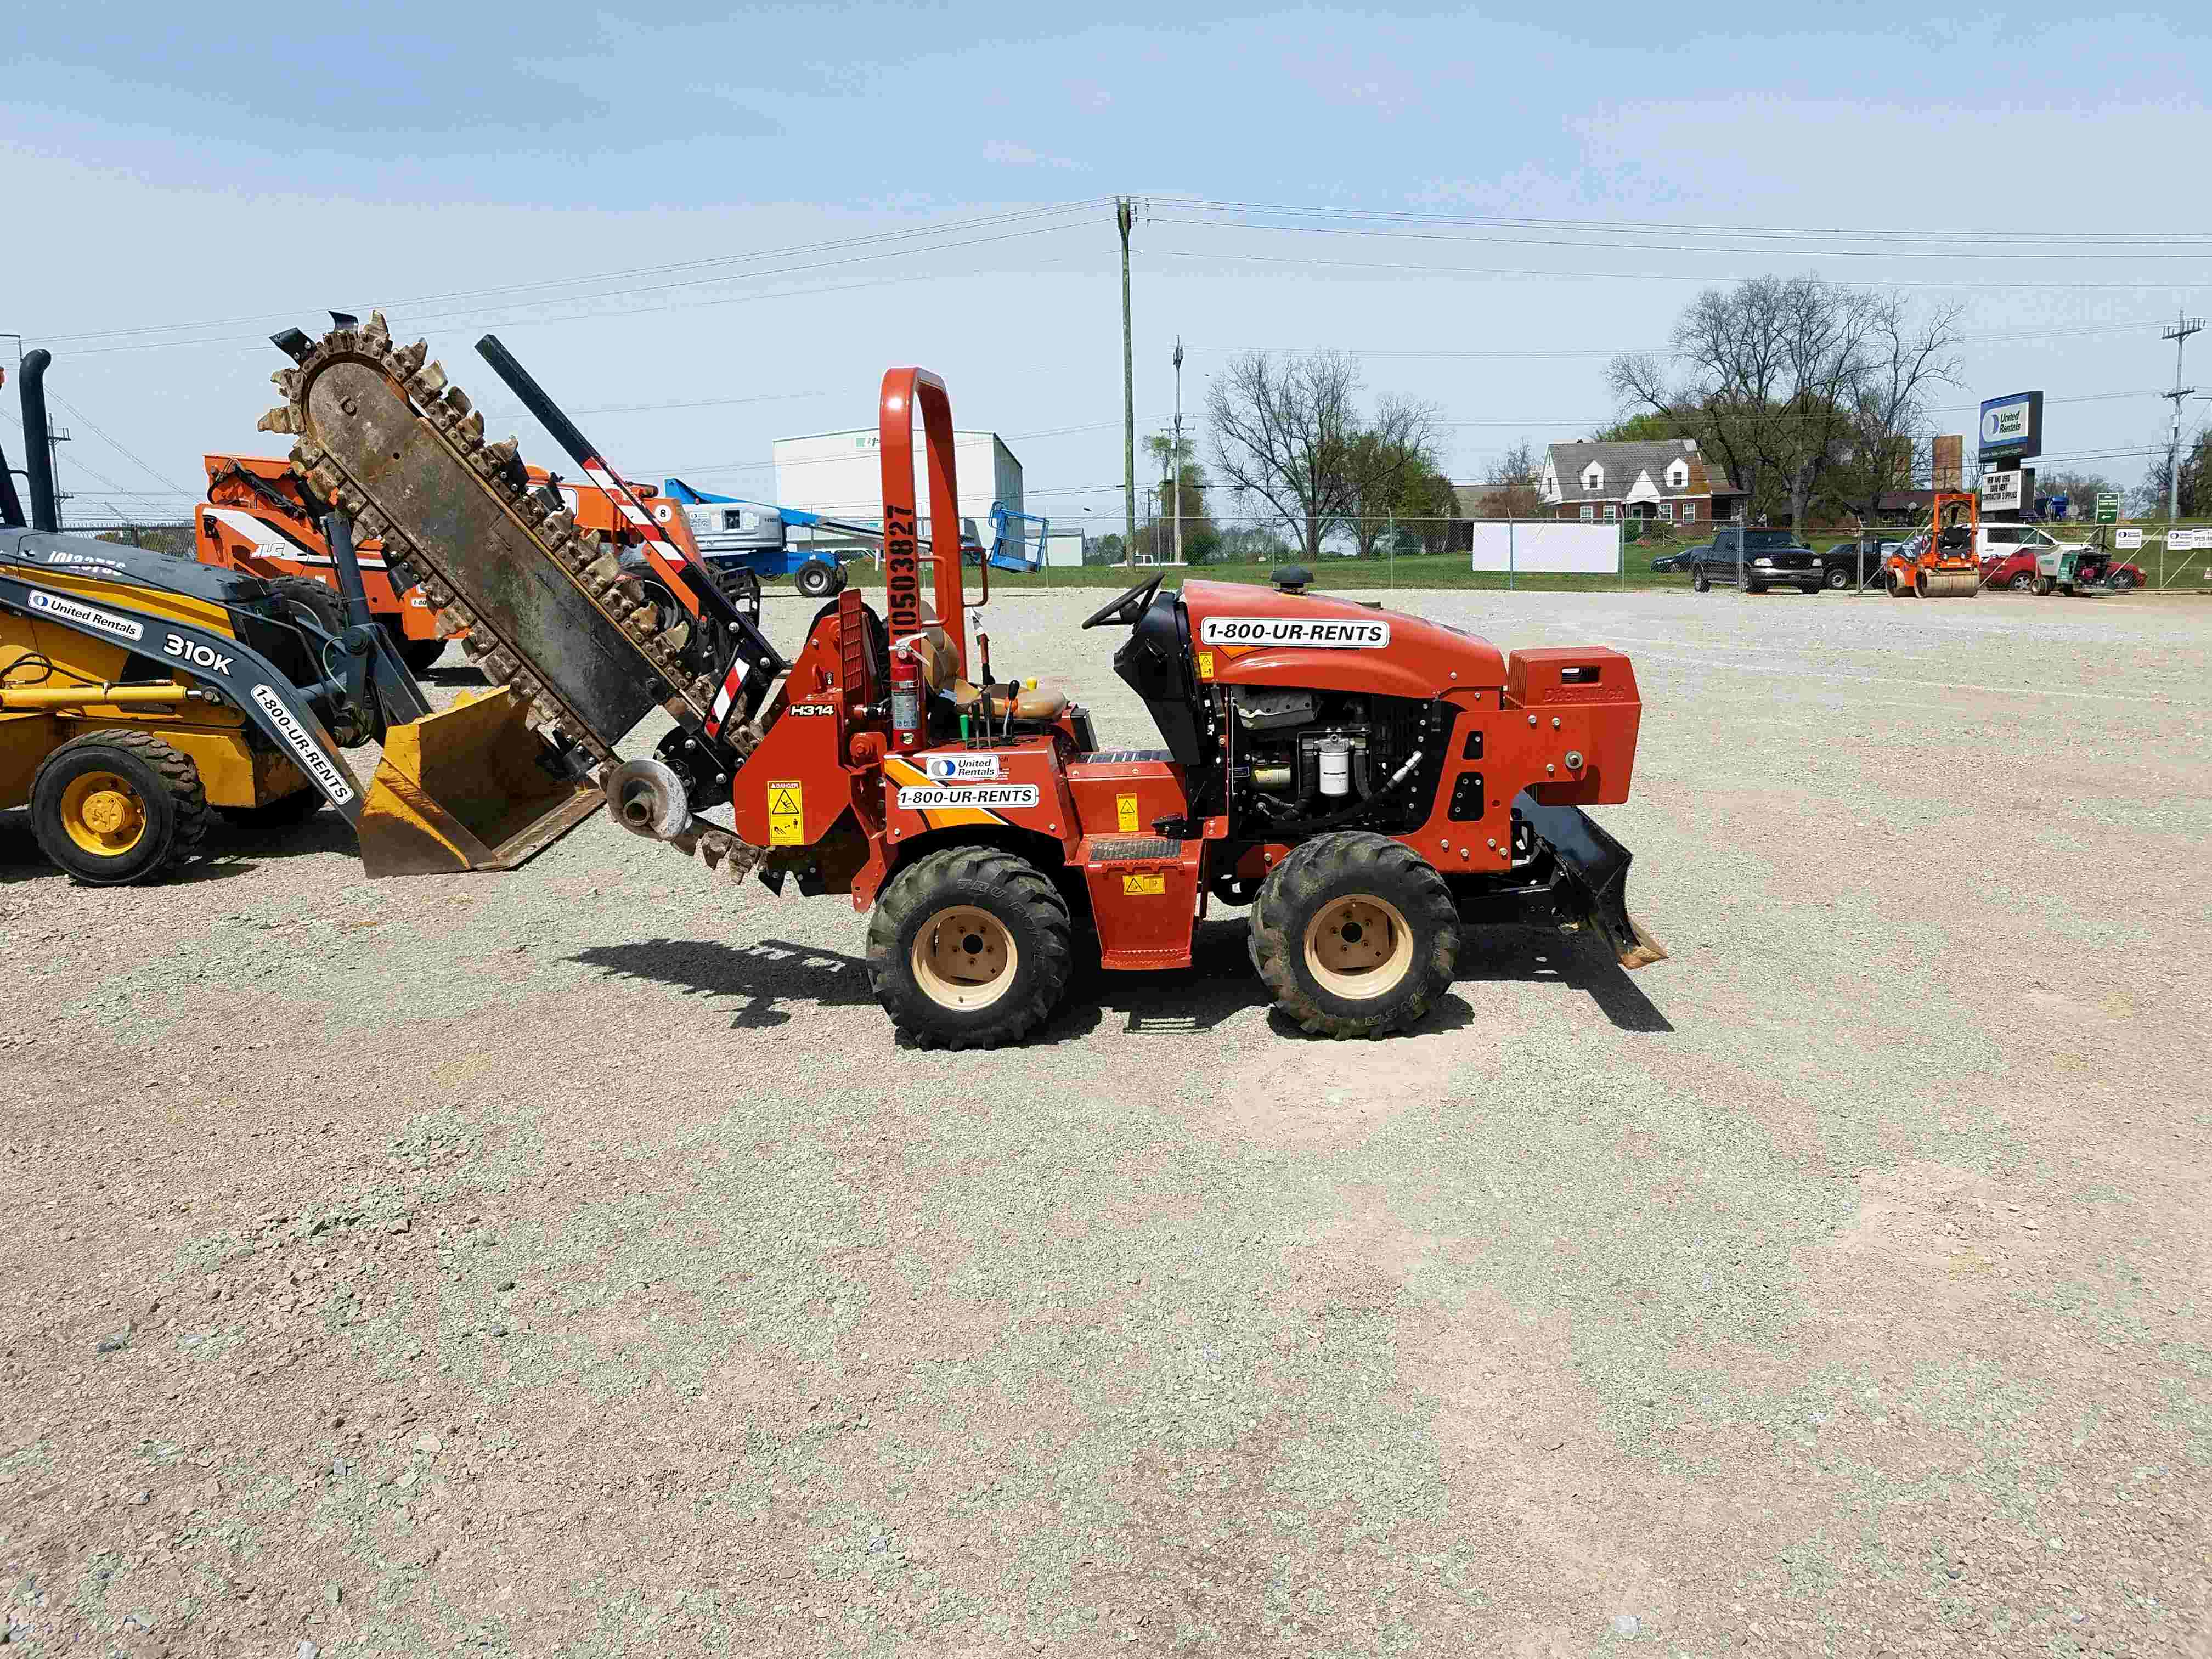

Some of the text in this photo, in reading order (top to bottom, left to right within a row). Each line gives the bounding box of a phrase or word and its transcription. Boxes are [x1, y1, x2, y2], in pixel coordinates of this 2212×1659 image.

[2000, 410, 2021, 424] United
[1999, 421, 2021, 434] Rentals
[660, 509, 666, 517] 8
[249, 543, 285, 558] JLG
[887, 505, 921, 636] 10503827
[50, 600, 137, 635] United Rentals
[1208, 623, 1382, 641] 1-800-UR-RENTS
[163, 633, 235, 676] 310K
[790, 704, 834, 716] H314
[256, 688, 348, 799] 1-800-UR-RENTS
[958, 759, 991, 768] United
[958, 768, 995, 776] Rentals
[900, 789, 1032, 804] 1-800-UR-RENTS
